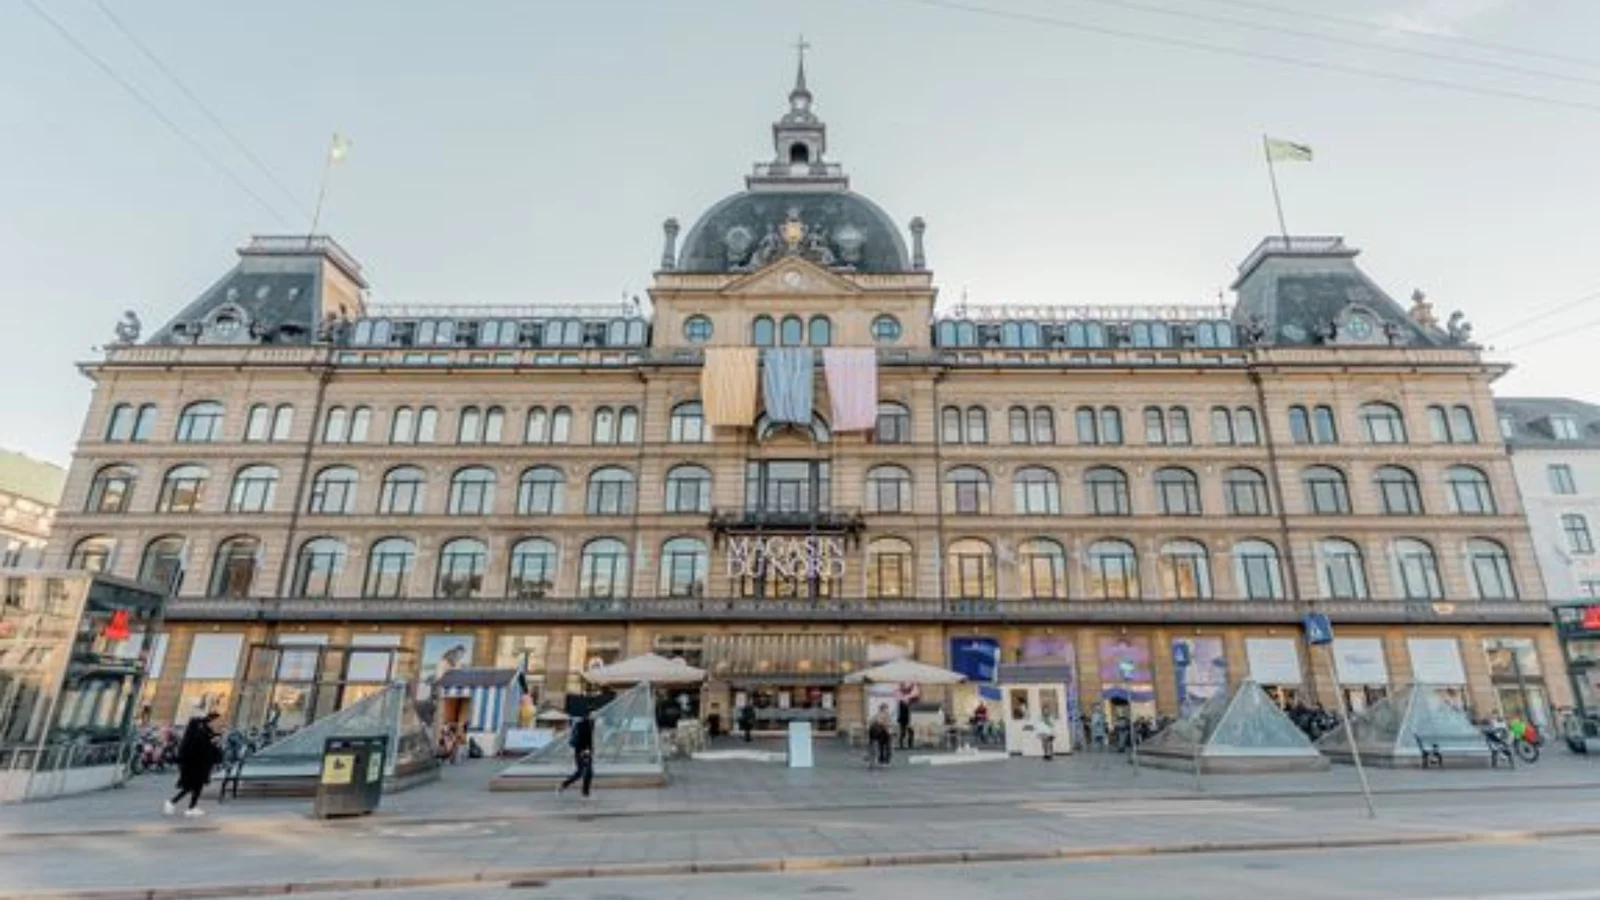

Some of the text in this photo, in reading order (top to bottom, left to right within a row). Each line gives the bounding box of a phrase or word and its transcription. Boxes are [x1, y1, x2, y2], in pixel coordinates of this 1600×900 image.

[727, 536, 845, 559] MAGASIN
[726, 557, 846, 578] DU NORD
